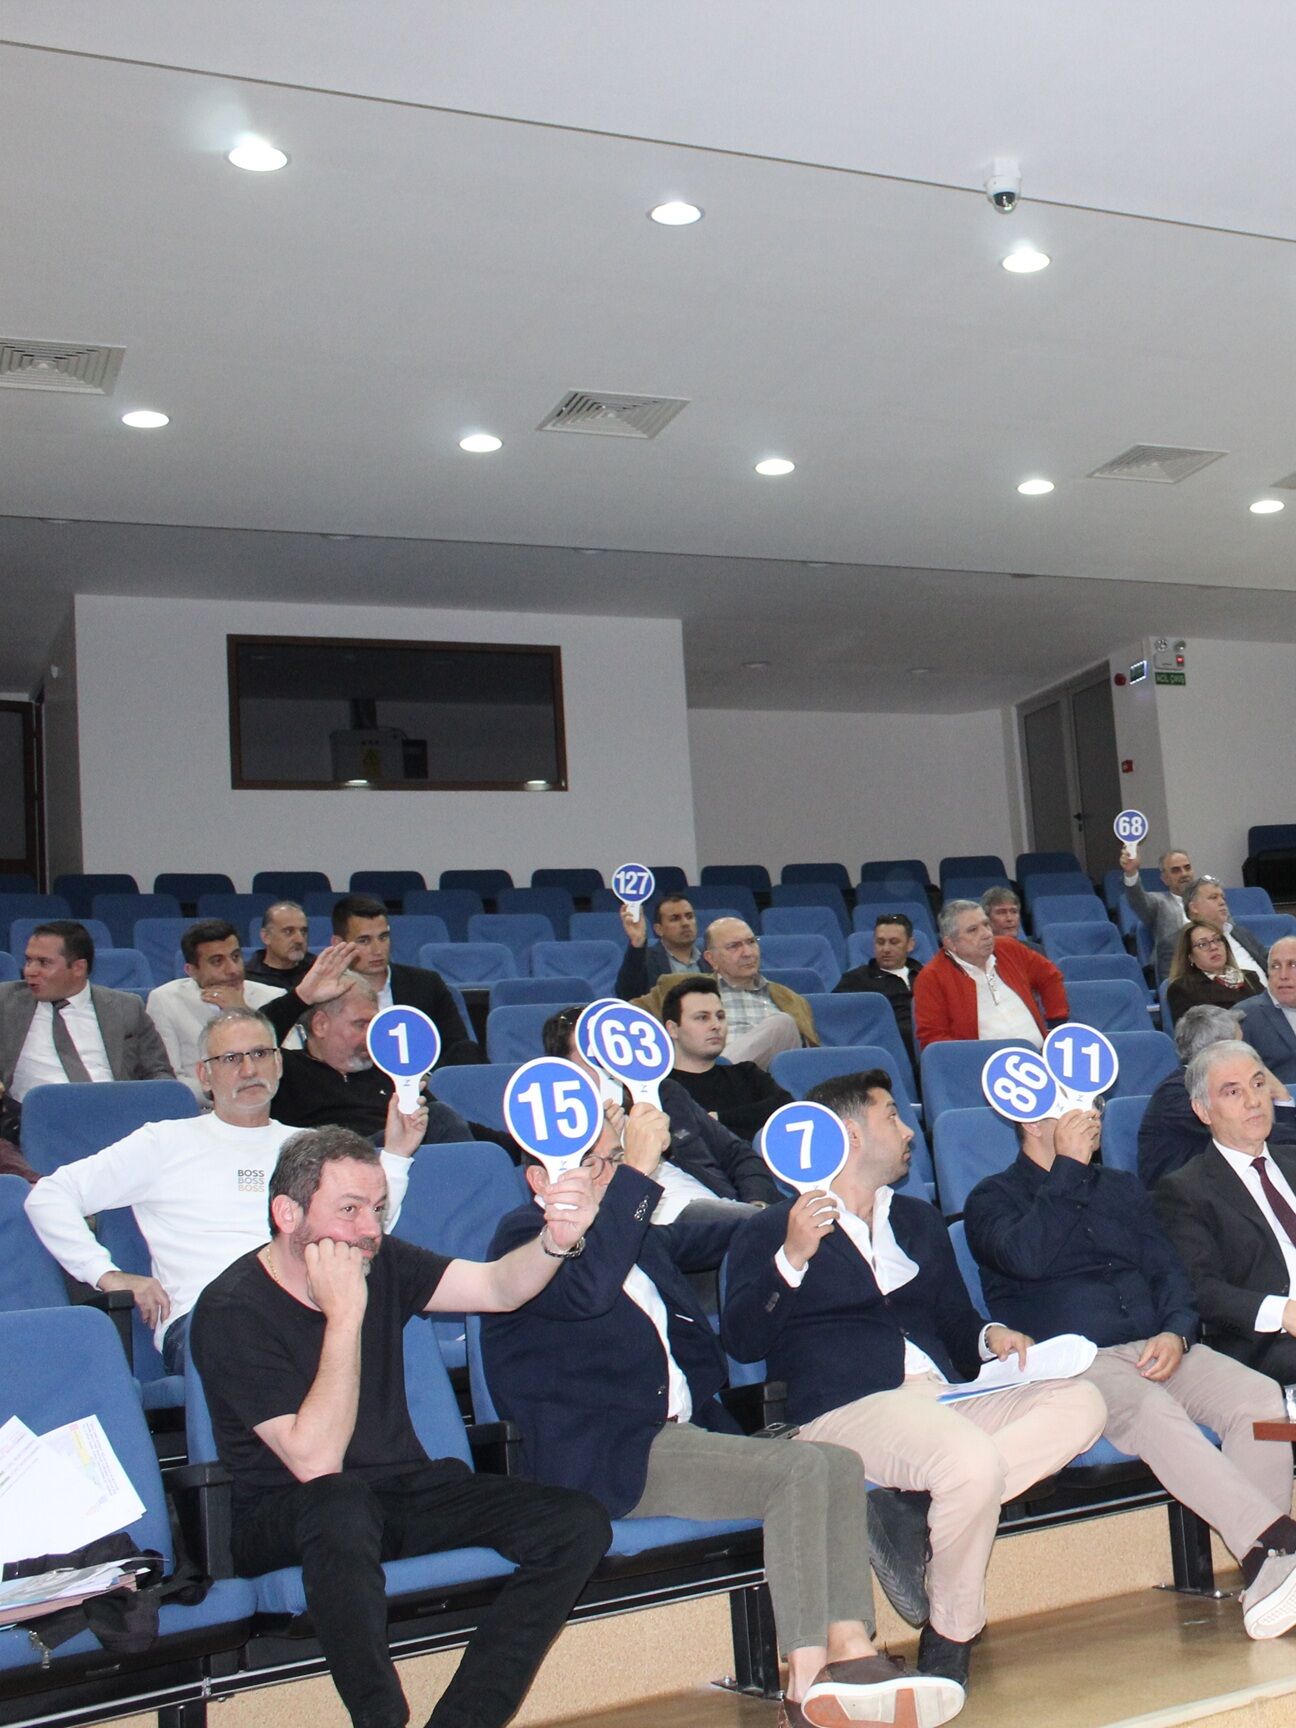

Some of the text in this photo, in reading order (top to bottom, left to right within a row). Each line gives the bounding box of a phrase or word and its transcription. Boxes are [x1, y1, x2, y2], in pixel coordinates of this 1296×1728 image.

[1119, 816, 1146, 835] 68
[616, 872, 649, 895] 127
[390, 1023, 410, 1064] 1
[601, 1019, 663, 1068] 63
[1054, 1037, 1100, 1083] 11
[994, 1055, 1048, 1112] 86
[518, 1080, 589, 1141] 15
[786, 1120, 814, 1170] 7
[238, 1169, 264, 1177] BOSS
[238, 1177, 264, 1185] BOSS
